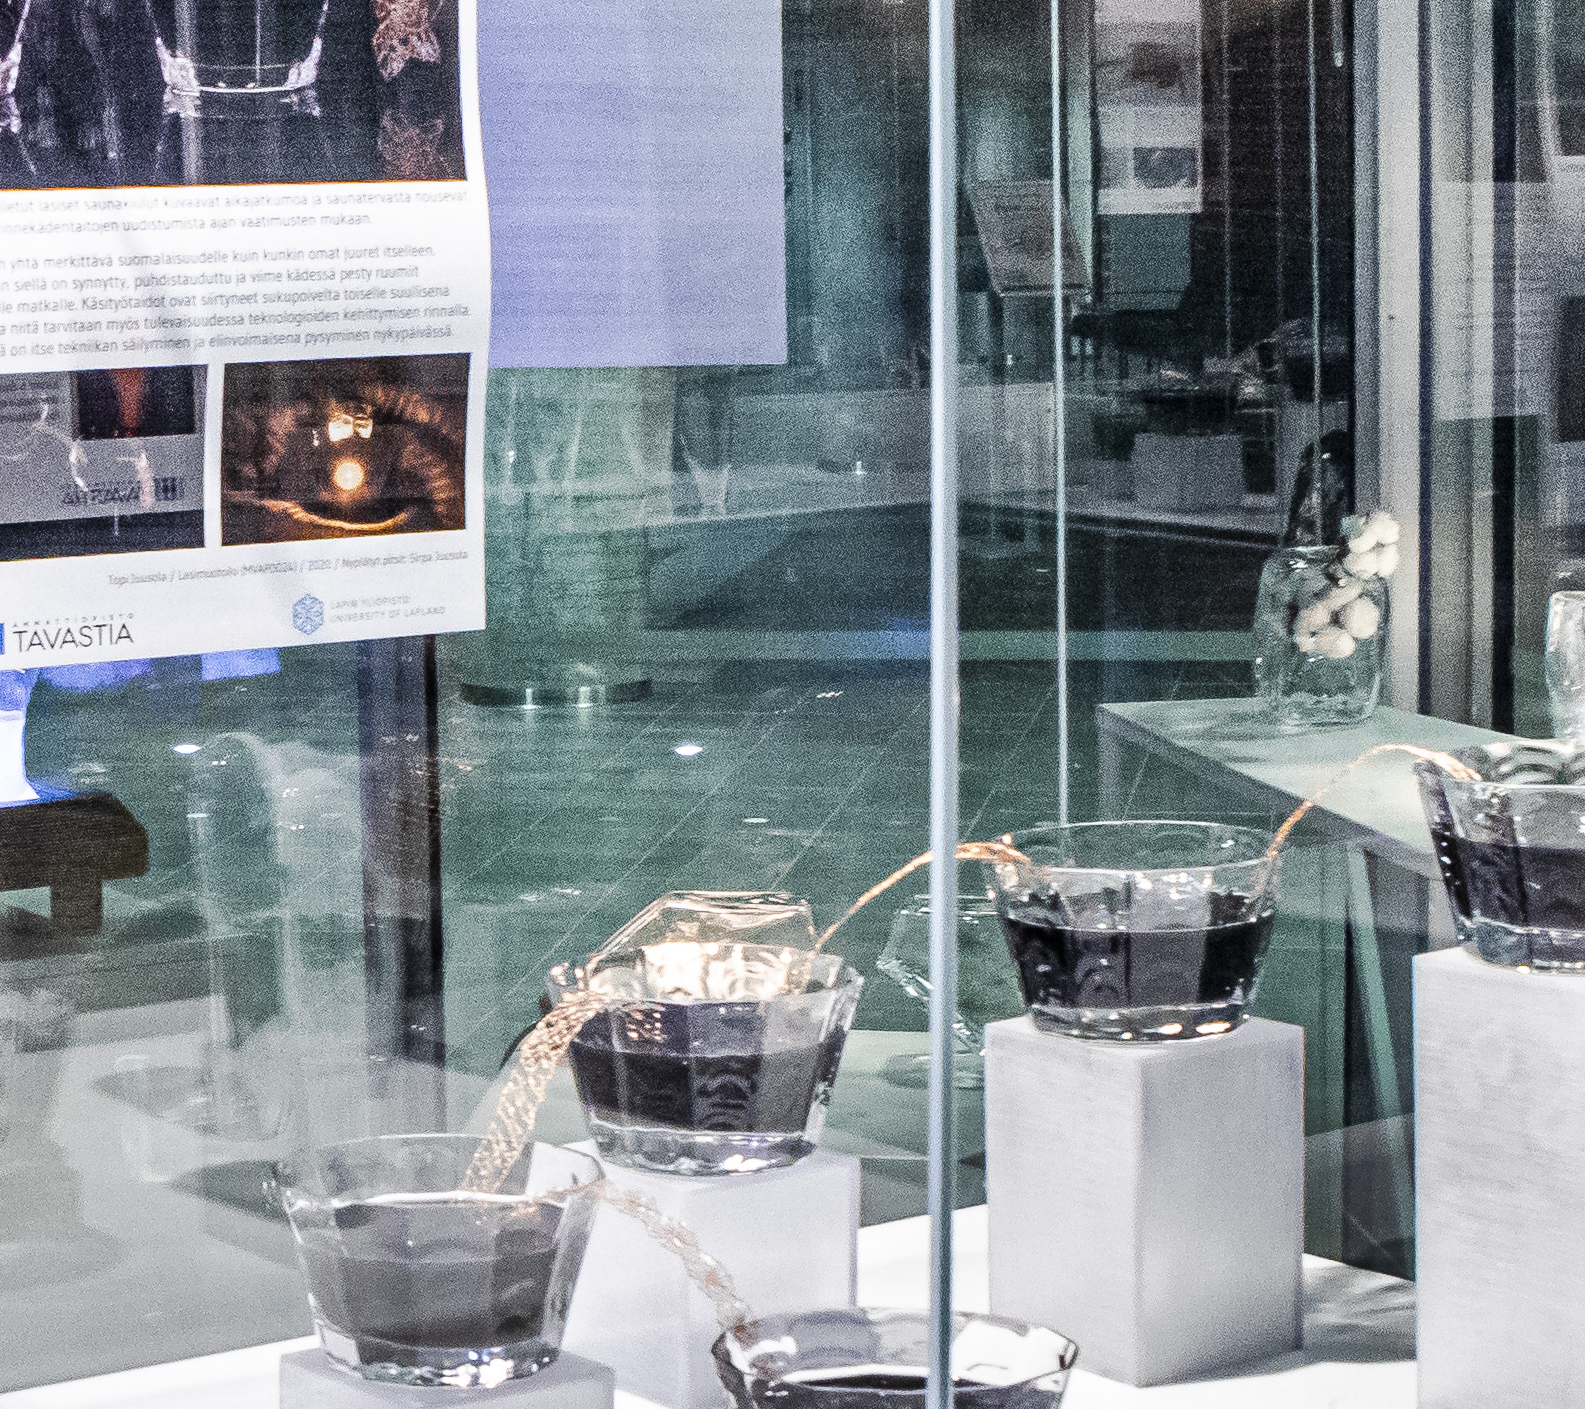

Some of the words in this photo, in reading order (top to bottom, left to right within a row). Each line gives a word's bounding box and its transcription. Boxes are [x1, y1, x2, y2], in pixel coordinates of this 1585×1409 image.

[37, 197, 80, 212] lasiset
[162, 193, 221, 209] kuvaavat
[224, 192, 309, 210] aikajatkumoa
[311, 191, 323, 209] ja
[326, 188, 412, 205] saunatervasta
[415, 187, 468, 203] nousevat
[122, 215, 207, 231] uudistumista
[209, 214, 237, 232] ajan
[239, 212, 317, 228] vaatimusten
[9, 255, 40, 274] yhtä
[42, 252, 114, 269] merkittävä
[117, 249, 229, 266] suomalaisuudelle
[231, 248, 260, 263] kuin
[262, 246, 306, 262] kunkin
[307, 245, 341, 260] omat
[343, 243, 381, 263] juuret
[13, 276, 48, 291] siellä
[50, 279, 69, 290] on
[133, 270, 233, 291] puhdistauduttu
[234, 269, 248, 287] ja
[249, 268, 284, 283] viime
[285, 266, 337, 282] kädessä
[339, 265, 373, 284] pesty
[374, 263, 420, 279] ruumiit
[80, 293, 167, 313] Käsityötaidot
[169, 292, 197, 307] ovat
[200, 289, 259, 309] siirtyneet
[261, 287, 341, 306] sukupolvelta
[342, 285, 388, 301] toiselle
[389, 283, 451, 299] suullisena
[9, 319, 40, 335] niitä
[42, 318, 103, 334] tarvitaan
[105, 316, 141, 334] myös
[143, 312, 246, 329] tulevaisuudessa
[247, 307, 340, 327] teknologioiden
[342, 304, 422, 323] kehittymisen
[9, 345, 28, 356] on
[30, 340, 55, 355] itse
[57, 338, 119, 354] tekniikan
[121, 335, 191, 354] säilyminen
[193, 333, 206, 352] ja
[208, 330, 302, 347] elinvoimaisena
[303, 327, 371, 347] pysyminen
[12, 623, 134, 653] TAVASTIA
